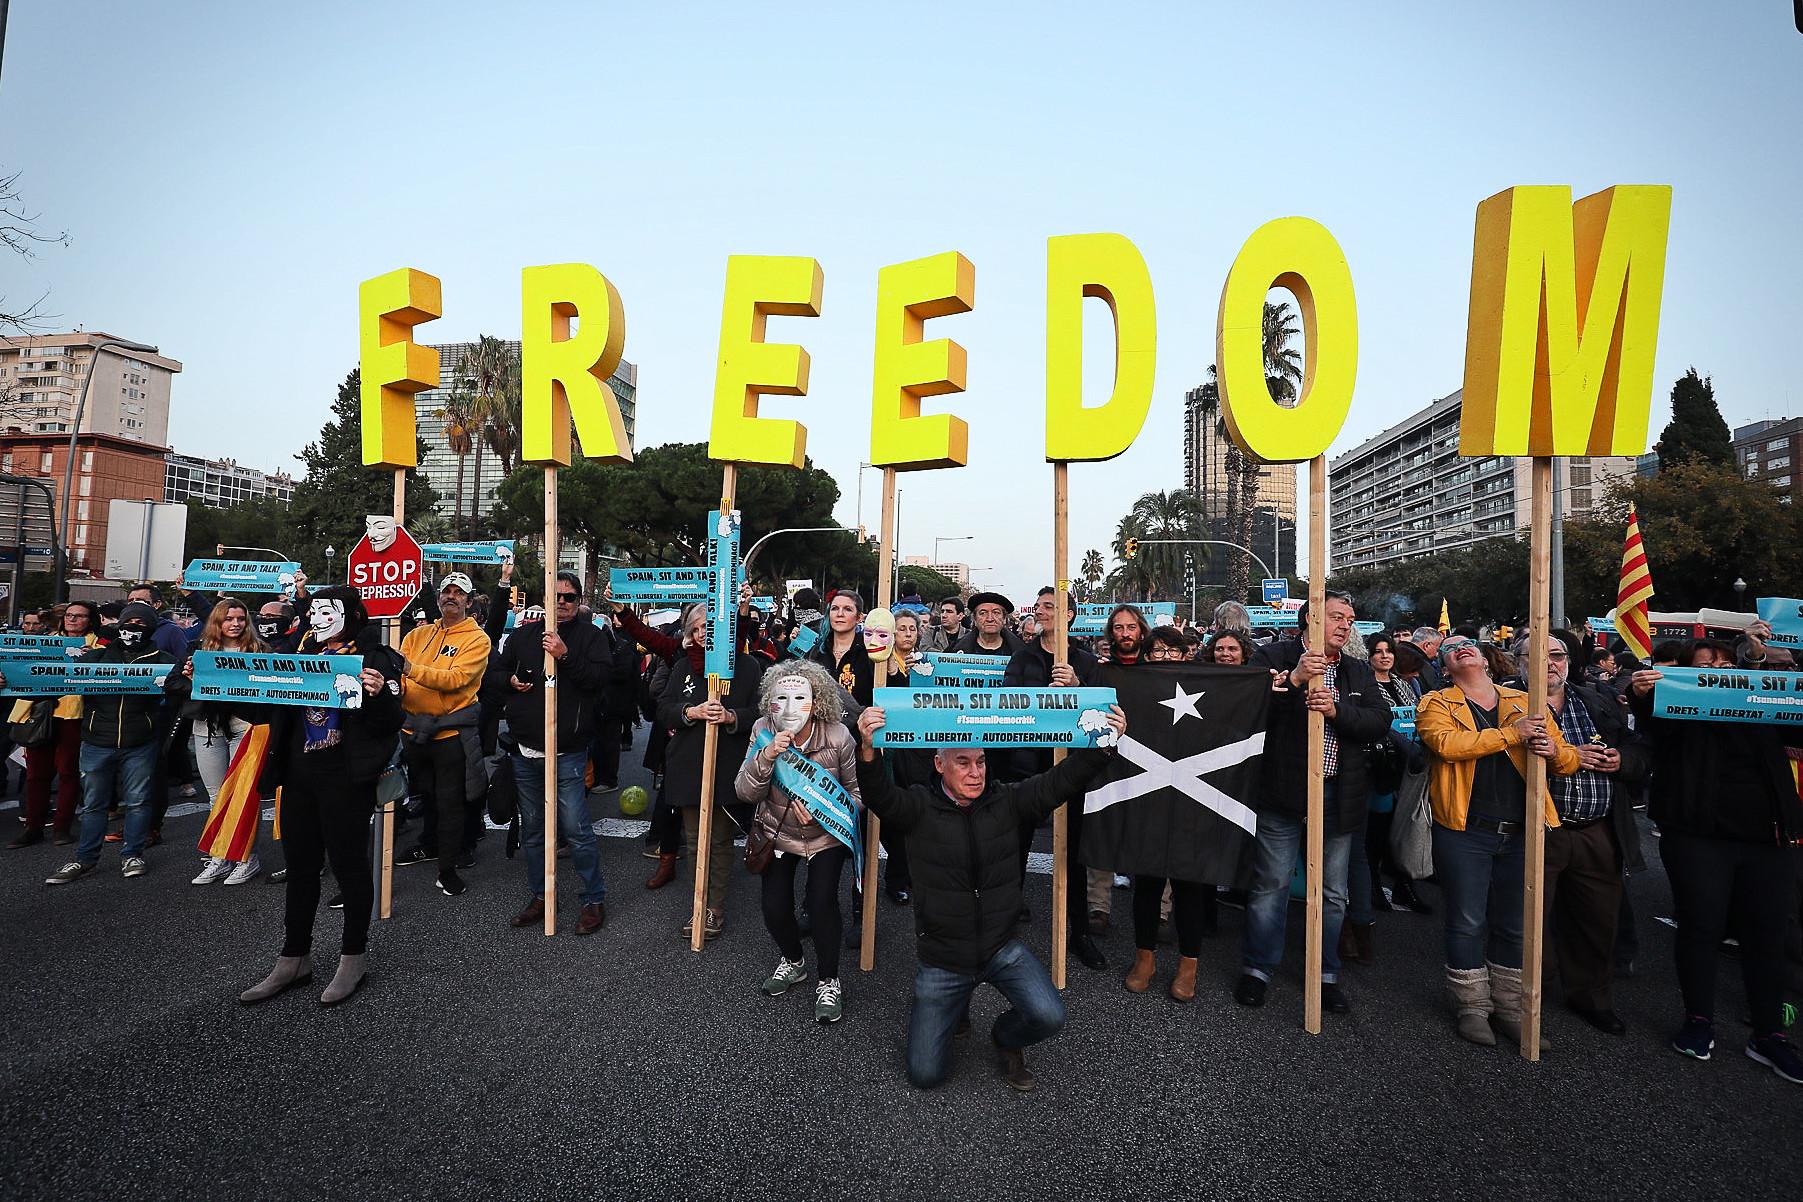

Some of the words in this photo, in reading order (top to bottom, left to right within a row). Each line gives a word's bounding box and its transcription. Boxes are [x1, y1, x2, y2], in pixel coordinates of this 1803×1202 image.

[359, 184, 1673, 471] FREEDOM
[709, 538, 718, 568] TALK!
[201, 562, 226, 573] SPAIN,
[228, 563, 240, 572] SIT
[241, 563, 258, 572] AND
[260, 564, 280, 573] TALK!
[353, 559, 416, 584] STOP
[627, 571, 656, 582] SPAIN,
[659, 571, 672, 580] SIT
[675, 572, 694, 580] AND
[697, 571, 708, 580] TA
[708, 596, 716, 612] SIT
[1092, 606, 1104, 616] SIT
[706, 616, 716, 652] SPAIN,
[1664, 628, 1687, 636] 1772
[3, 638, 16, 646] SIT
[18, 638, 36, 646] AND
[40, 638, 63, 647] TALK!
[1771, 633, 1798, 644] DRETS
[214, 656, 250, 671] SPAIN,
[254, 658, 268, 671] SIT
[272, 659, 296, 672] AND
[300, 660, 332, 674] TALK!
[30, 666, 69, 677] SPAIN,
[74, 666, 90, 676] SIT
[94, 667, 118, 676] AND
[123, 668, 153, 677] TALK!
[934, 676, 960, 687] TALK!
[964, 678, 985, 688] AND
[1698, 674, 1754, 692] SPAIN,
[1762, 676, 1788, 692] SIT
[200, 686, 220, 696] DRETS
[228, 688, 260, 698] LLIBERTAT
[266, 689, 330, 702] AUTODETERMINACIÓ
[912, 693, 964, 710] SPAIN,
[970, 694, 992, 709] SIT
[1000, 694, 1031, 709] AND
[1036, 694, 1079, 710] TALK!
[1404, 710, 1413, 718] SIT
[1666, 706, 1698, 716] DRETS
[1710, 708, 1764, 719] LLIBERTAT
[885, 732, 915, 742] DRETS
[924, 732, 973, 742] LLIBERTAT
[982, 731, 1073, 743] AUTODETERMINACIÓ
[782, 750, 816, 784] SPAIN,
[818, 776, 838, 796] SIT
[836, 791, 855, 816] AND
